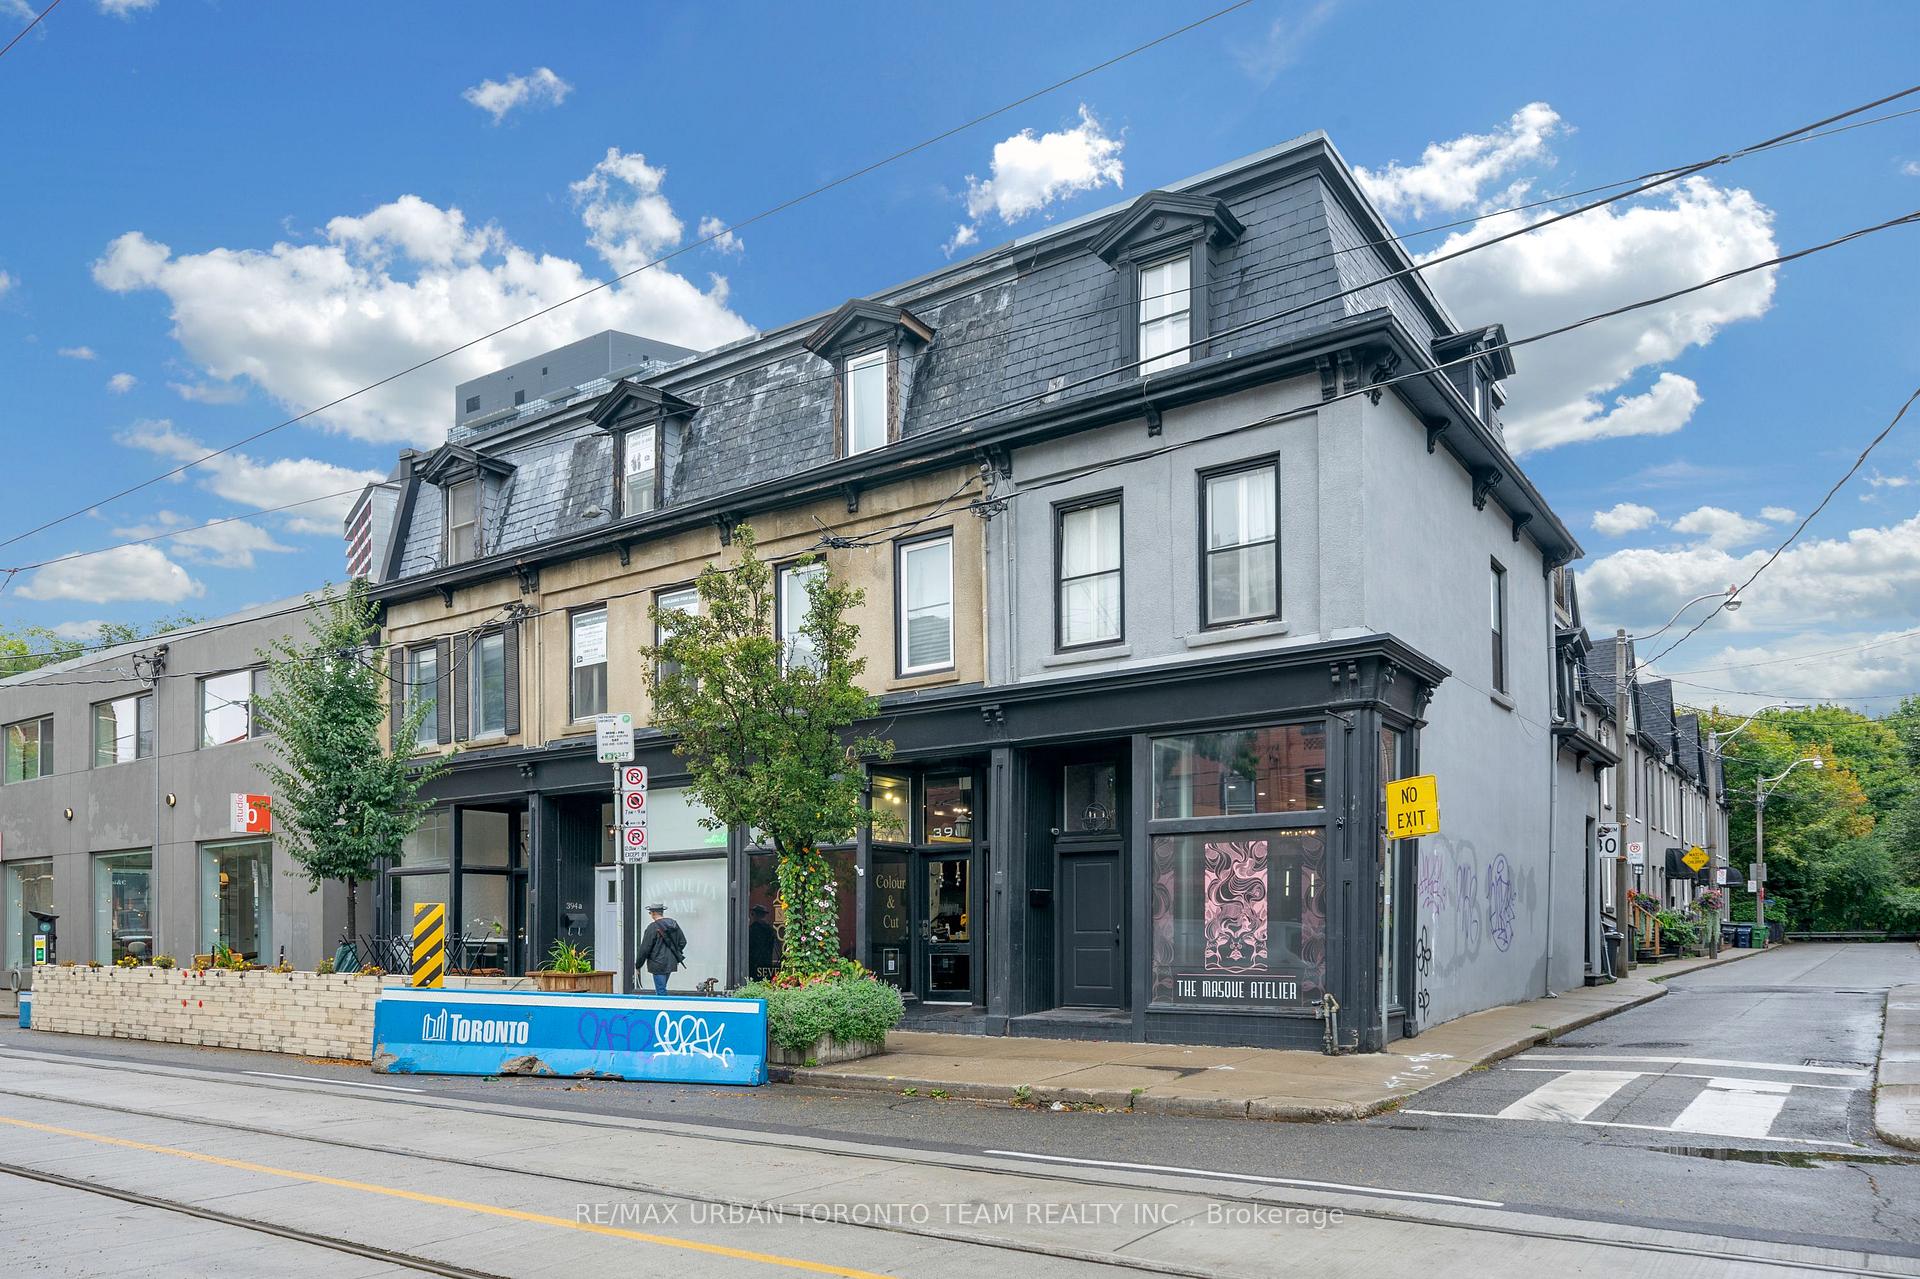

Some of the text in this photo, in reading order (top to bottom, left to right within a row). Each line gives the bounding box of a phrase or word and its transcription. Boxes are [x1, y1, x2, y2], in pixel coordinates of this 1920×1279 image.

[1401, 786, 1418, 805] NO
[236, 793, 244, 823] studio
[1397, 809, 1426, 829] EXIT
[933, 826, 959, 838] 39
[876, 874, 906, 889] Colour
[566, 902, 583, 910] 394a
[886, 894, 896, 909] &
[883, 915, 899, 929] Cut
[1177, 980, 1297, 1000] THE MASQUE ATELIER
[450, 1013, 529, 1045] TORONTO
